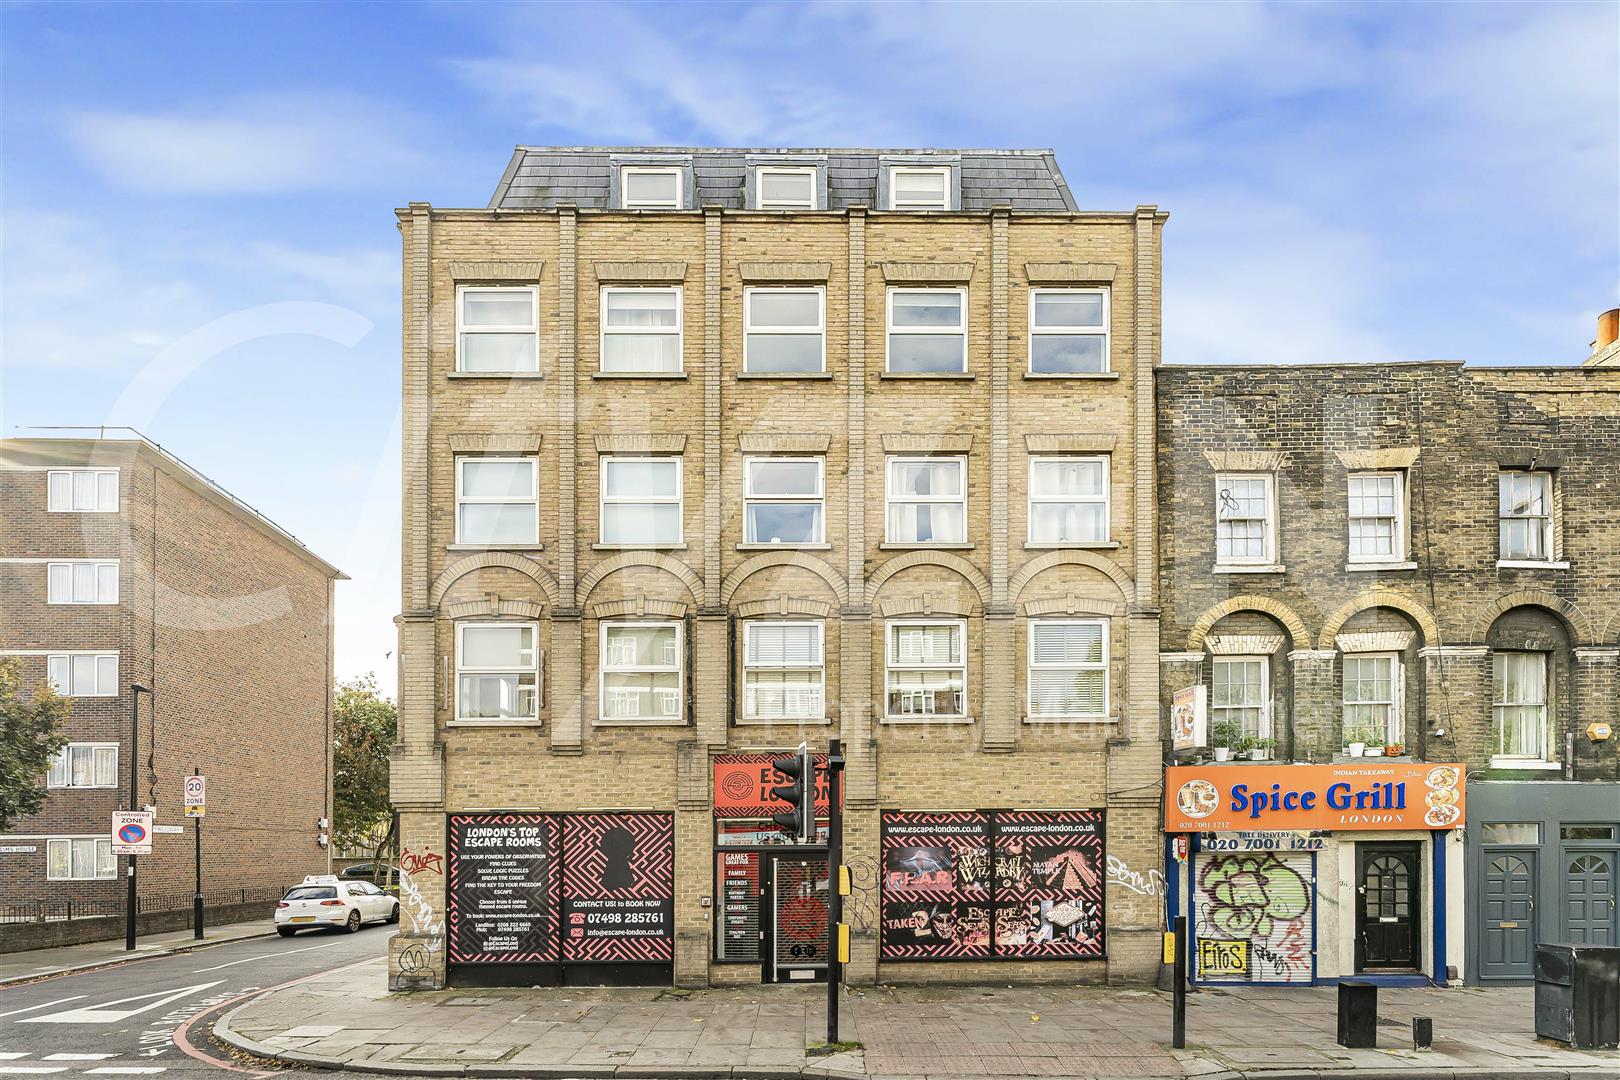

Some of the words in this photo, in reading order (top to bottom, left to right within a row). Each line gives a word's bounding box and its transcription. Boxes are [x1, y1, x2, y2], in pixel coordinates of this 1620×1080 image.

[188, 782, 201, 792] 20
[1230, 783, 1316, 818] Spice
[1326, 782, 1407, 810] Grill
[1340, 814, 1405, 823] LONDON
[467, 827, 517, 837] LONDON'S
[519, 827, 539, 837] TOP
[887, 824, 982, 833] www.escape-london.co.uk
[1001, 823, 1095, 833] www.escape-london.co.uk
[465, 838, 503, 847] ESCAPE
[506, 837, 541, 847] ROOMS
[1207, 839, 1239, 850] 020
[1244, 838, 1280, 850] 7001
[1290, 838, 1324, 849] 1212
[573, 900, 604, 908] CONTACT
[587, 912, 622, 924] 07498
[624, 912, 664, 924] 285761
[887, 917, 922, 930] TAKEN
[587, 928, 664, 936] info@escape-london.co.uk
